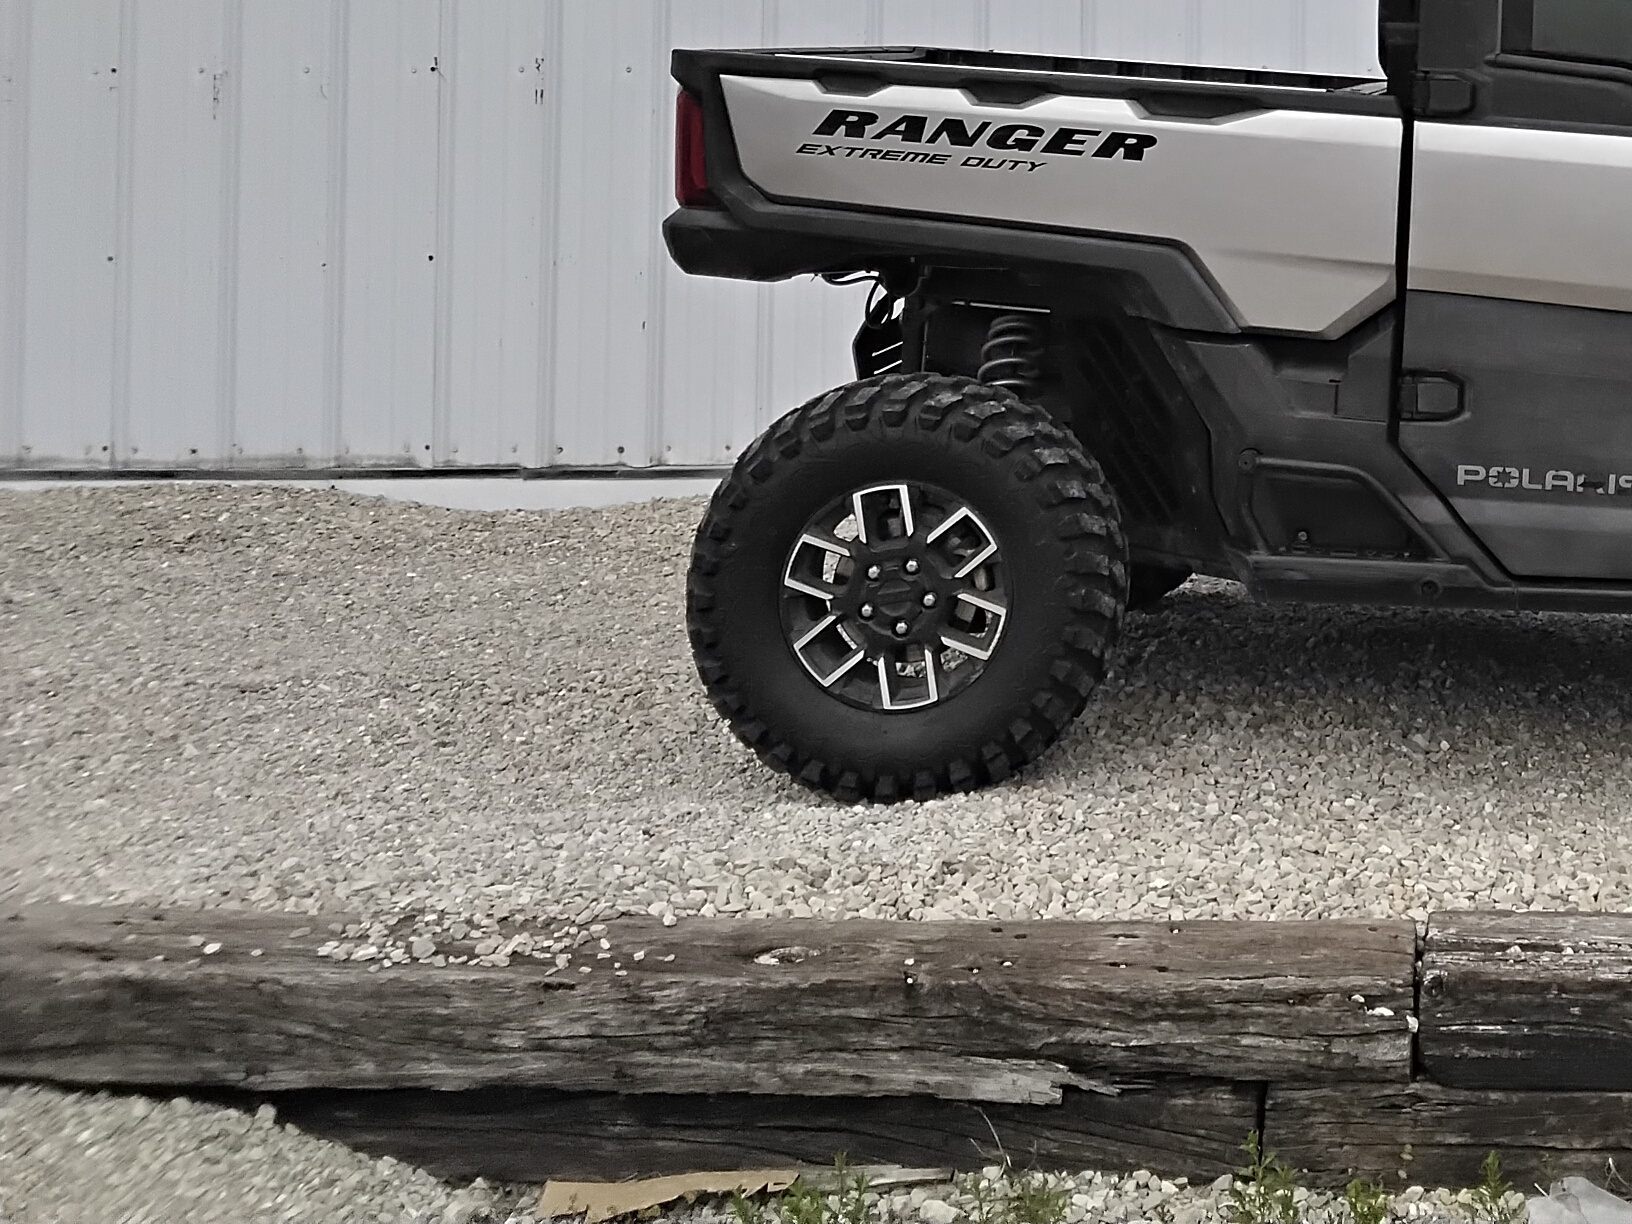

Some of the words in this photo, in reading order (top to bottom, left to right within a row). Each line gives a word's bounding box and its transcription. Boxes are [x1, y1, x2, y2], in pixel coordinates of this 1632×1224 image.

[812, 109, 1158, 161] RANGER
[796, 143, 952, 165] EXTREME
[960, 156, 1047, 172] DUTY
